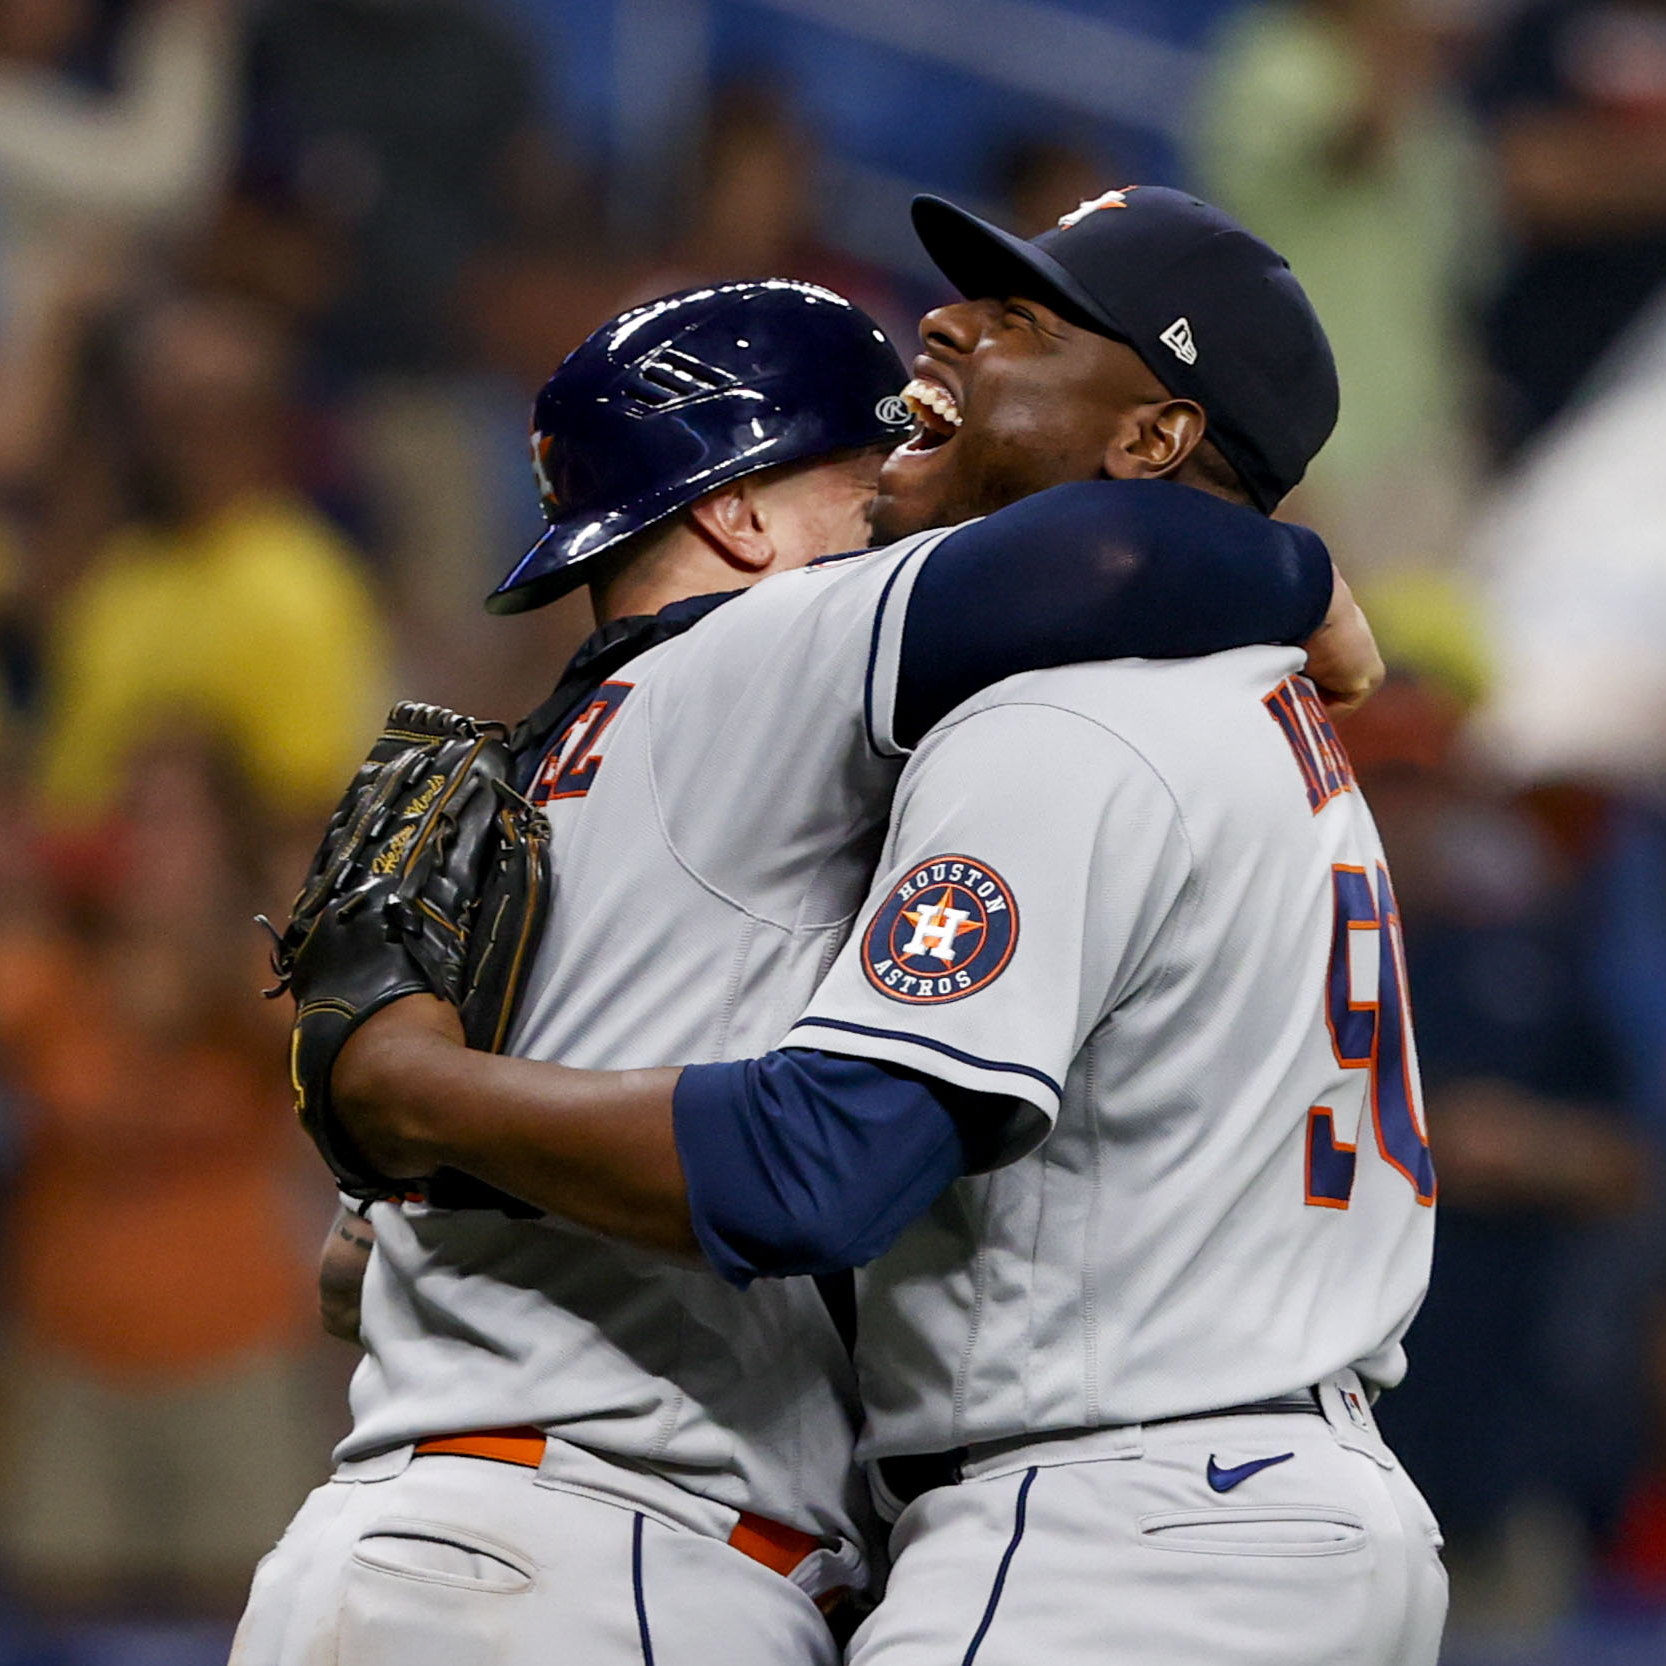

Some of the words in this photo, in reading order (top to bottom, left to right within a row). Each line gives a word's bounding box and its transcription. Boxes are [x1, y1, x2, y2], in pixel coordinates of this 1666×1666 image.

[898, 862, 1007, 914] HOUSTON
[901, 903, 971, 962] H
[873, 958, 972, 997] ASTROS
